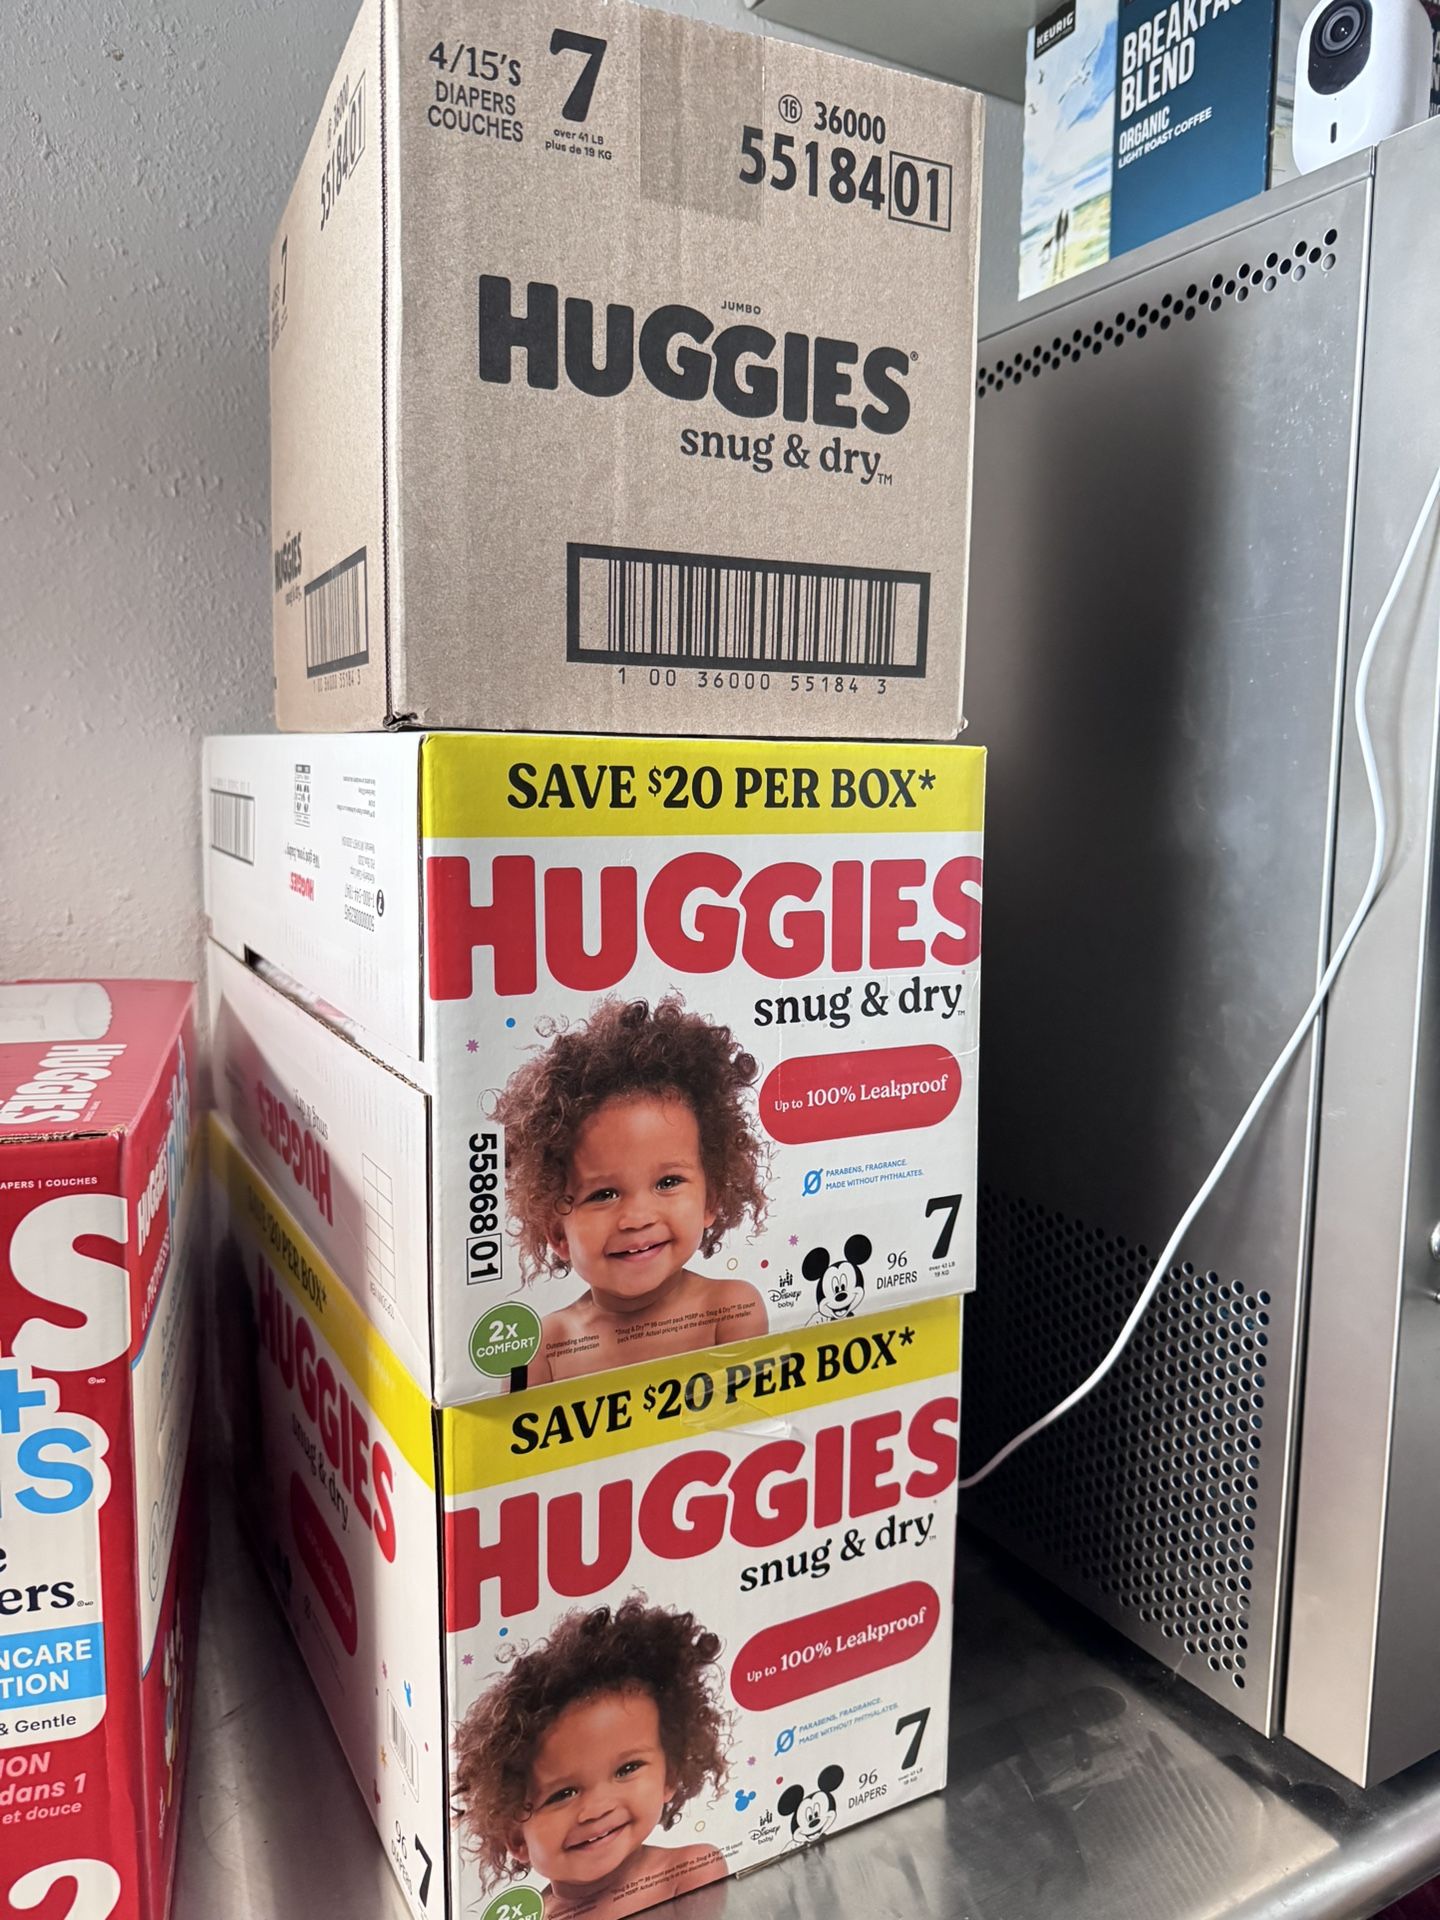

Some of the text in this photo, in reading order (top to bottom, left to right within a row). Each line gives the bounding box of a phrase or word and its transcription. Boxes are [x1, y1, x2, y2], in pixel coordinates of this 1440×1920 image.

[1036, 11, 1075, 48] KEURIG
[549, 28, 608, 123] 7
[1120, 36, 1196, 121] BLEND
[435, 80, 516, 116] DIAPERS
[427, 105, 524, 142] COUCHES
[553, 128, 576, 140] over
[592, 133, 604, 146] LB
[814, 101, 886, 145] 36000
[1118, 105, 1170, 155] ORGANIC
[1118, 106, 1213, 169] LIGHT ROAST COFFEE
[545, 139, 566, 153] plus
[569, 144, 581, 155] de
[598, 149, 613, 161] KG
[719, 299, 763, 317] JUMBO
[680, 426, 773, 474] snug
[783, 435, 811, 468] &
[618, 666, 887, 696] 1 00 36000 55184 3
[506, 762, 638, 811] SAVE
[647, 765, 724, 810] $20
[734, 767, 820, 808] PER
[754, 984, 853, 1029] snug
[860, 980, 888, 1017] &
[0, 1043, 128, 1125] HUGGIES
[774, 1074, 949, 1113] Up to 100% Leakproof
[257, 1080, 334, 1228] HUGGIES
[45, 1176, 98, 1187] COUCHES
[825, 1179, 846, 1190] MADE
[847, 1175, 879, 1188] WITHOUT
[924, 1193, 963, 1260] 7
[886, 1250, 908, 1270] 96
[876, 1270, 918, 1290] DIAPERS
[777, 1300, 795, 1309] baby
[476, 1337, 535, 1358] COMFORT
[488, 1319, 519, 1343] 2x
[258, 1253, 397, 1565] HUGGIES
[510, 1389, 632, 1456] SAVE
[642, 1371, 714, 1421] $20
[723, 1352, 806, 1404] PER
[445, 1395, 959, 1634] HUGGIES
[740, 1537, 833, 1593] snug
[840, 1529, 867, 1558] &
[746, 1606, 928, 1683] Up to 100% Leakproof
[15, 1714, 77, 1733] Gentle
[895, 1706, 932, 1770] 7
[0, 1773, 87, 1806] dans 1
[847, 1783, 888, 1809] DIAPERS
[858, 1768, 879, 1789] 96
[2, 1801, 82, 1825] et douce
[414, 1832, 433, 1908] 7
